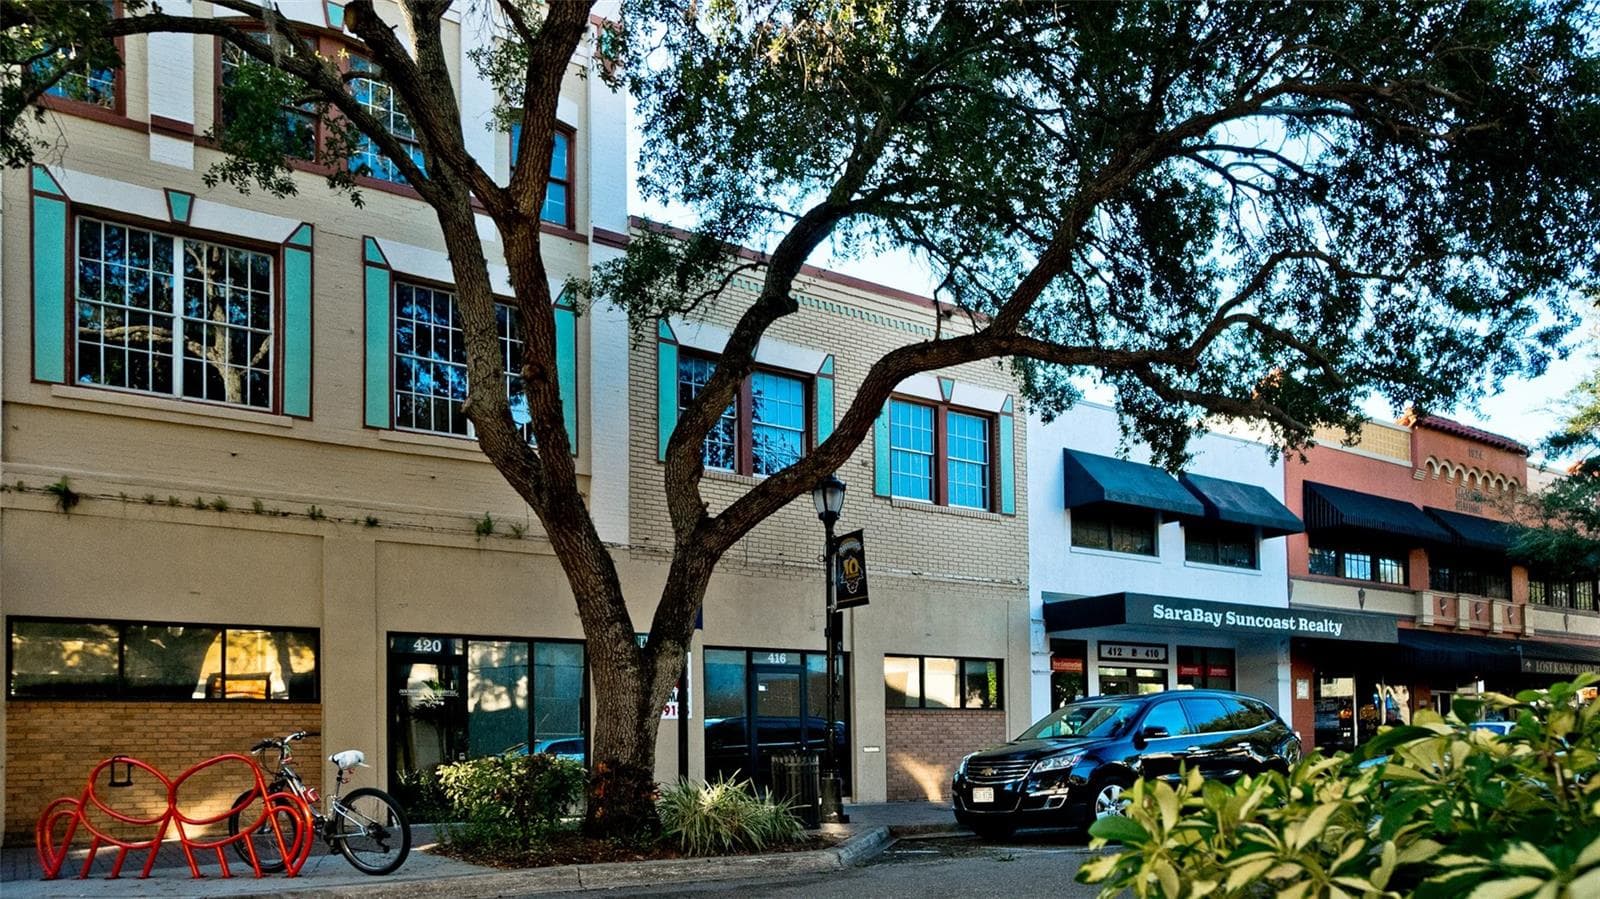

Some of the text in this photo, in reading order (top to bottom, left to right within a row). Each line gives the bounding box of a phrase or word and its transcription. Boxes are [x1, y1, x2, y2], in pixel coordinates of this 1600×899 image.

[1153, 604, 1343, 637] SaraBay Suncoast Realty
[413, 639, 442, 653] 420
[768, 653, 786, 664] 416
[1107, 647, 1122, 657] 412
[1145, 649, 1159, 658] 410
